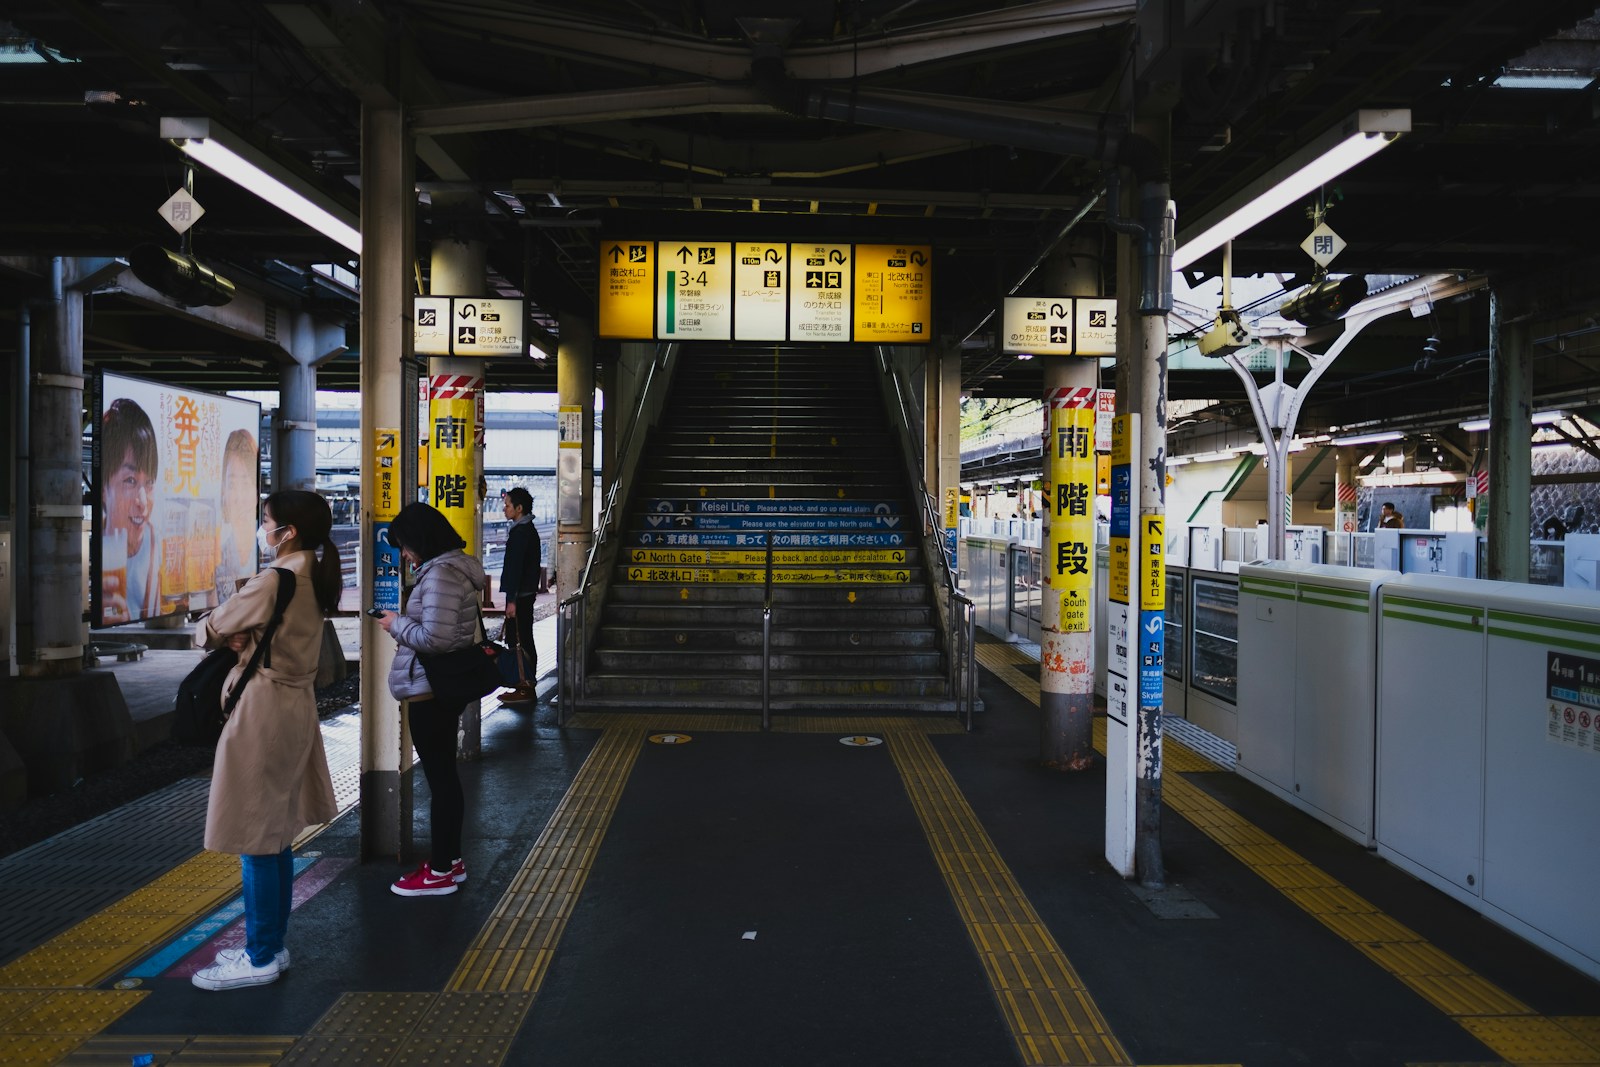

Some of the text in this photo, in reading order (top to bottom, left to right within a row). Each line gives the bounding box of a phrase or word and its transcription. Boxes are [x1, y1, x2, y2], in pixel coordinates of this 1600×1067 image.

[172, 201, 192, 221] 閉
[1313, 235, 1333, 255] 閉
[610, 268, 646, 278] 南改札口
[888, 272, 923, 282] 北改札口
[818, 292, 842, 300] 京成線
[804, 301, 842, 309] のりかえ口
[799, 324, 842, 332] 成田空港方面
[480, 336, 516, 344] のりかえ口
[1010, 334, 1047, 342] のりかえ口
[174, 395, 200, 494] 発見
[382, 472, 392, 509] 南改札口
[1057, 424, 1088, 576] 南階段
[702, 502, 728, 512] Keisei
[732, 502, 750, 512] Line
[666, 534, 699, 545] 京成線
[650, 553, 676, 563] North
[680, 554, 702, 563] Gate
[745, 554, 766, 562] Pleas
[804, 554, 817, 562] and
[820, 556, 828, 564] go
[831, 556, 840, 564] up
[648, 570, 692, 581] 北改札口
[1151, 560, 1160, 597] 南改札口
[1064, 598, 1086, 606] South
[1066, 610, 1084, 620] gate
[1064, 621, 1086, 631] (exit)
